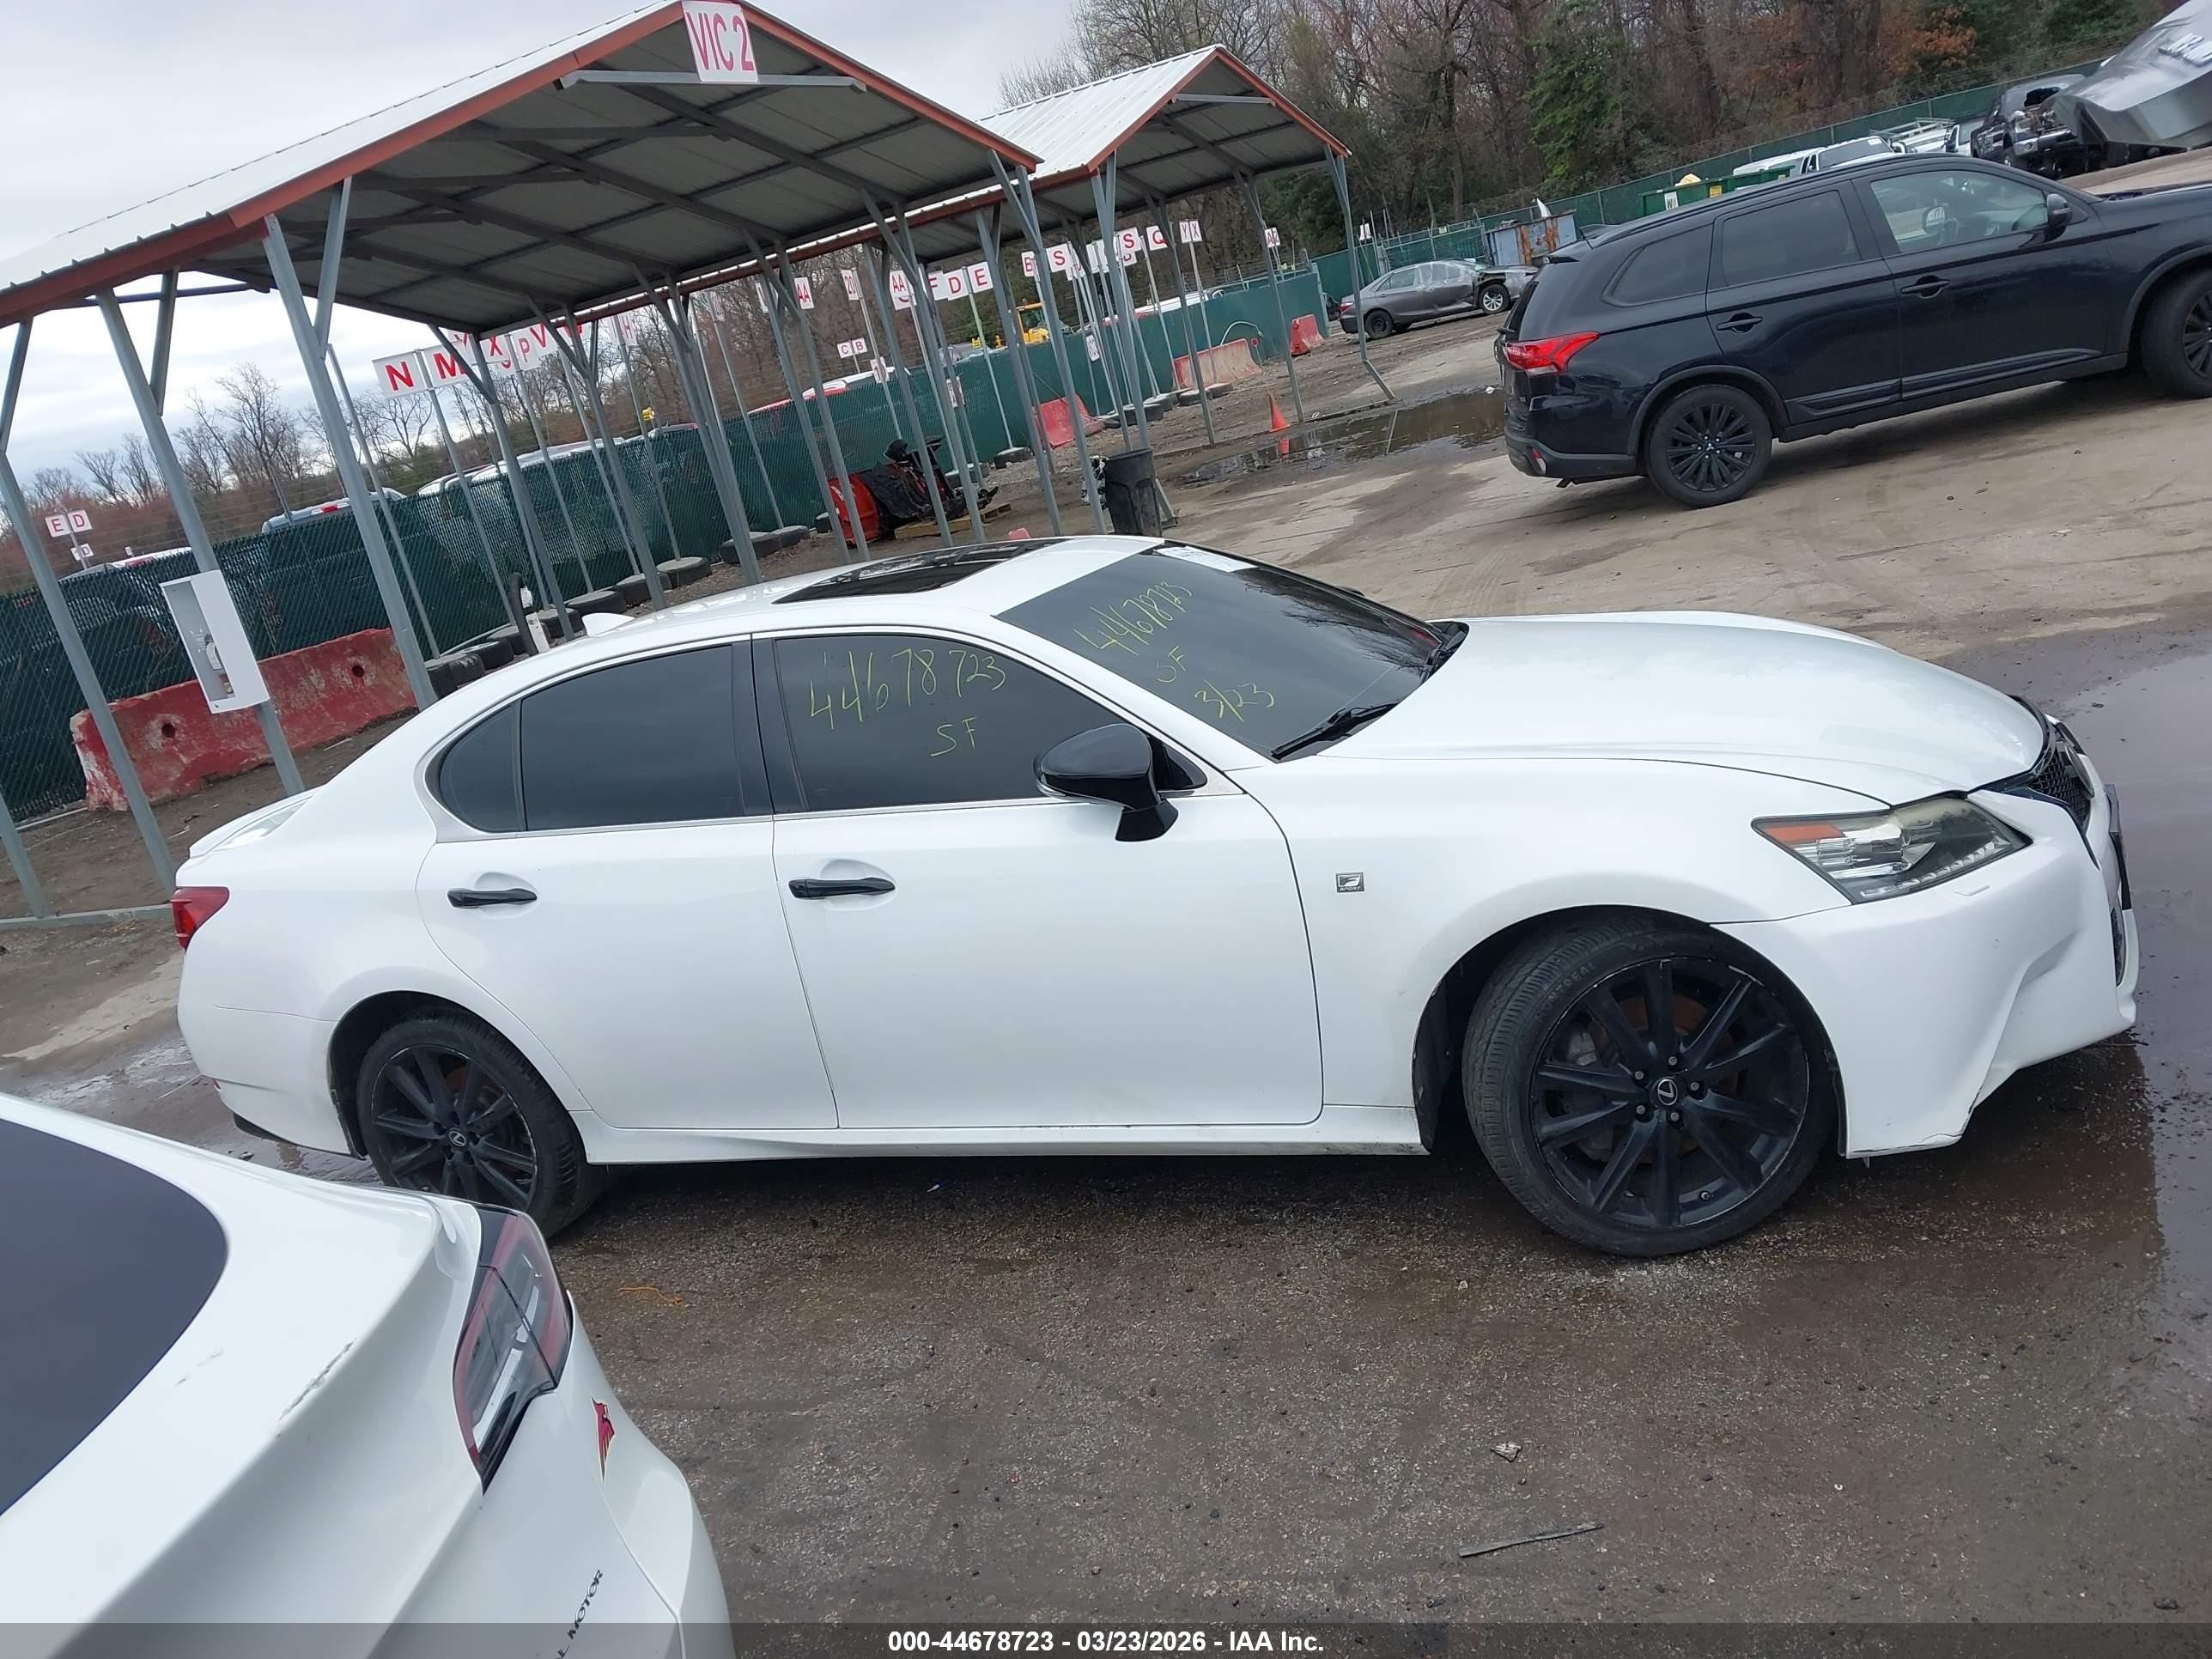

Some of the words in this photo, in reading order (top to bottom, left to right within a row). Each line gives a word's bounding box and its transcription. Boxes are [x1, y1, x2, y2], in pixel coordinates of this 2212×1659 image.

[1123, 233, 1135, 249] S
[1152, 229, 1168, 244] Q
[1053, 250, 1066, 266] S
[891, 274, 906, 293] AA
[948, 276, 962, 294] D
[974, 268, 988, 287] E
[795, 283, 811, 302] AA
[530, 323, 546, 348] V
[855, 341, 864, 351] B
[385, 361, 414, 392] N
[433, 352, 467, 380] M
[52, 518, 64, 532] E
[73, 514, 84, 528] D
[810, 647, 1006, 730] 44678723
[1194, 679, 1275, 722] 3/23
[930, 716, 979, 757] SF
[568, 1569, 603, 1640] MOTOR
